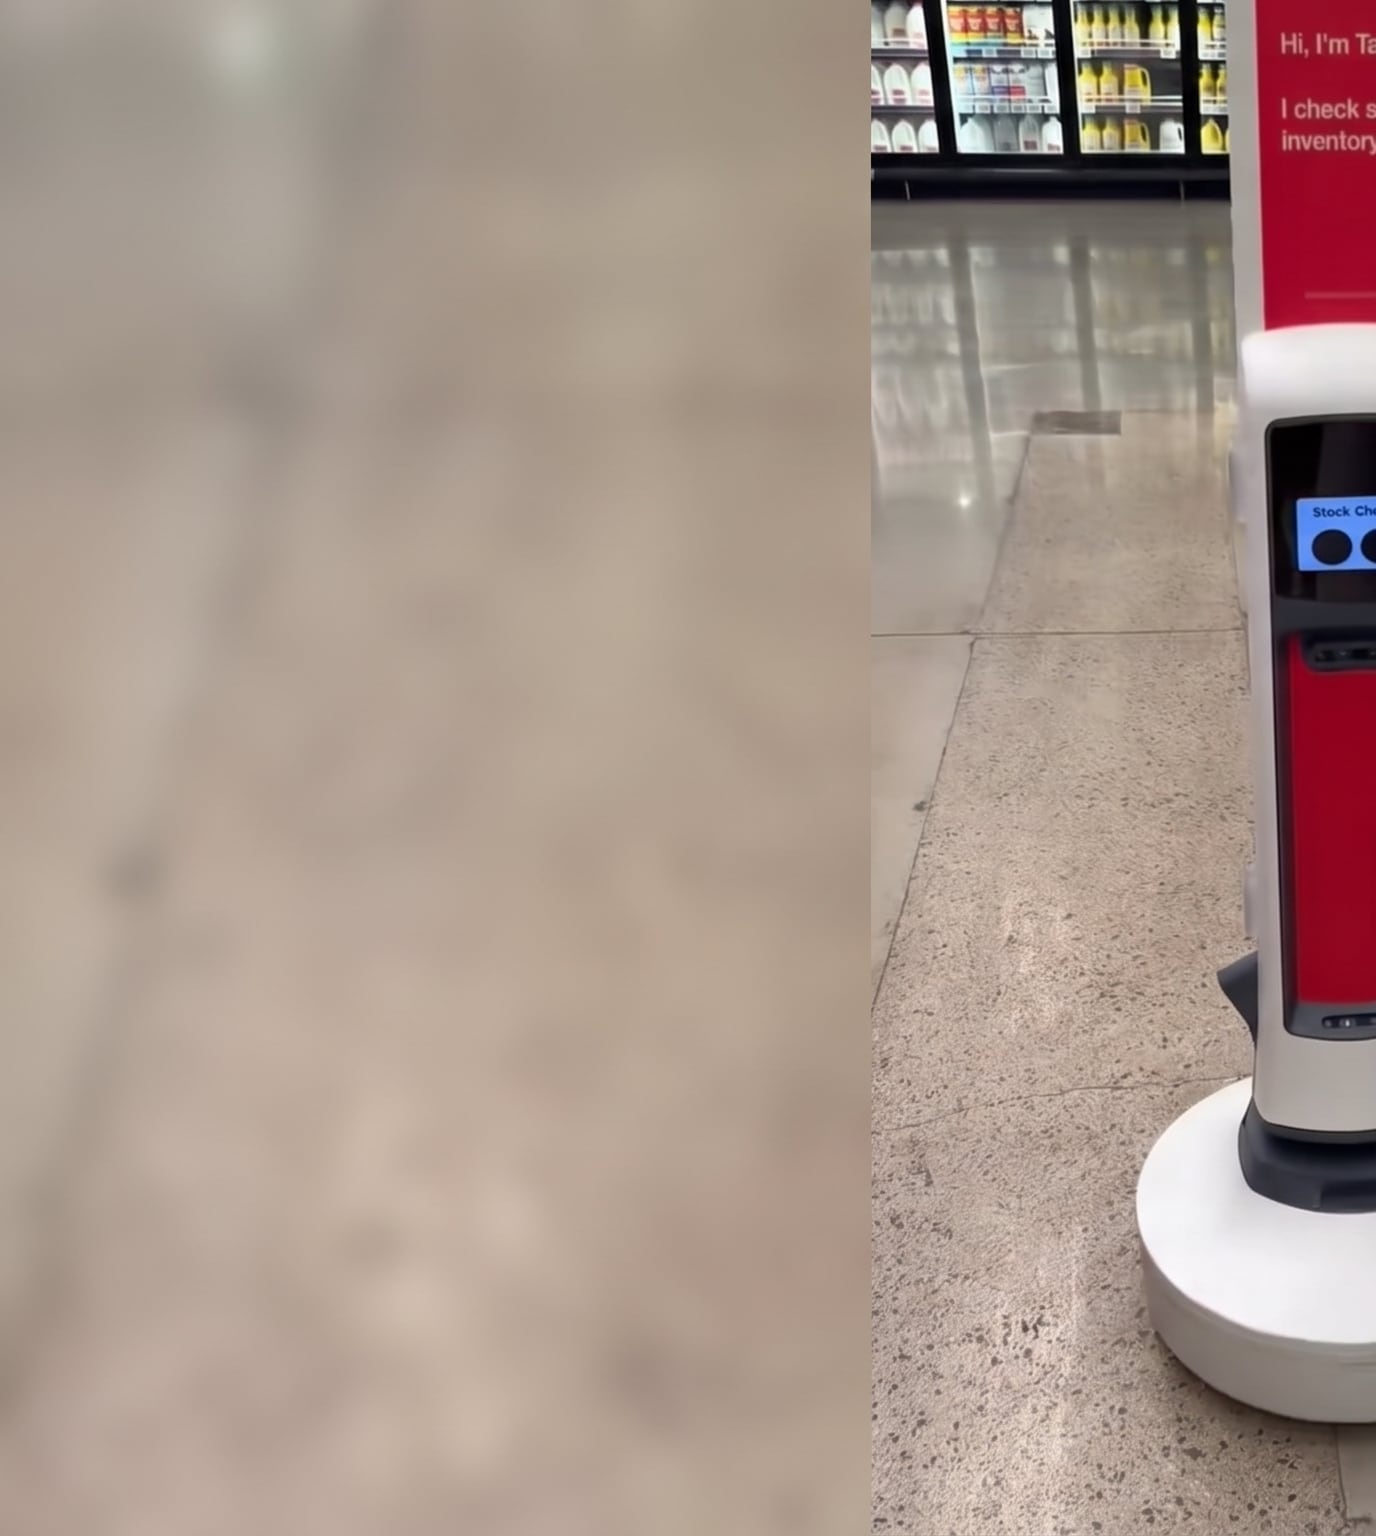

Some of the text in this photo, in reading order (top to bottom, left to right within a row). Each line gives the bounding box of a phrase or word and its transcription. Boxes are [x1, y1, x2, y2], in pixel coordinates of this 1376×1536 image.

[1280, 32, 1309, 58] Hi,
[1315, 33, 1350, 55] I'm
[1281, 98, 1287, 119] I
[1293, 98, 1360, 119] check
[1313, 506, 1350, 518] Stock
